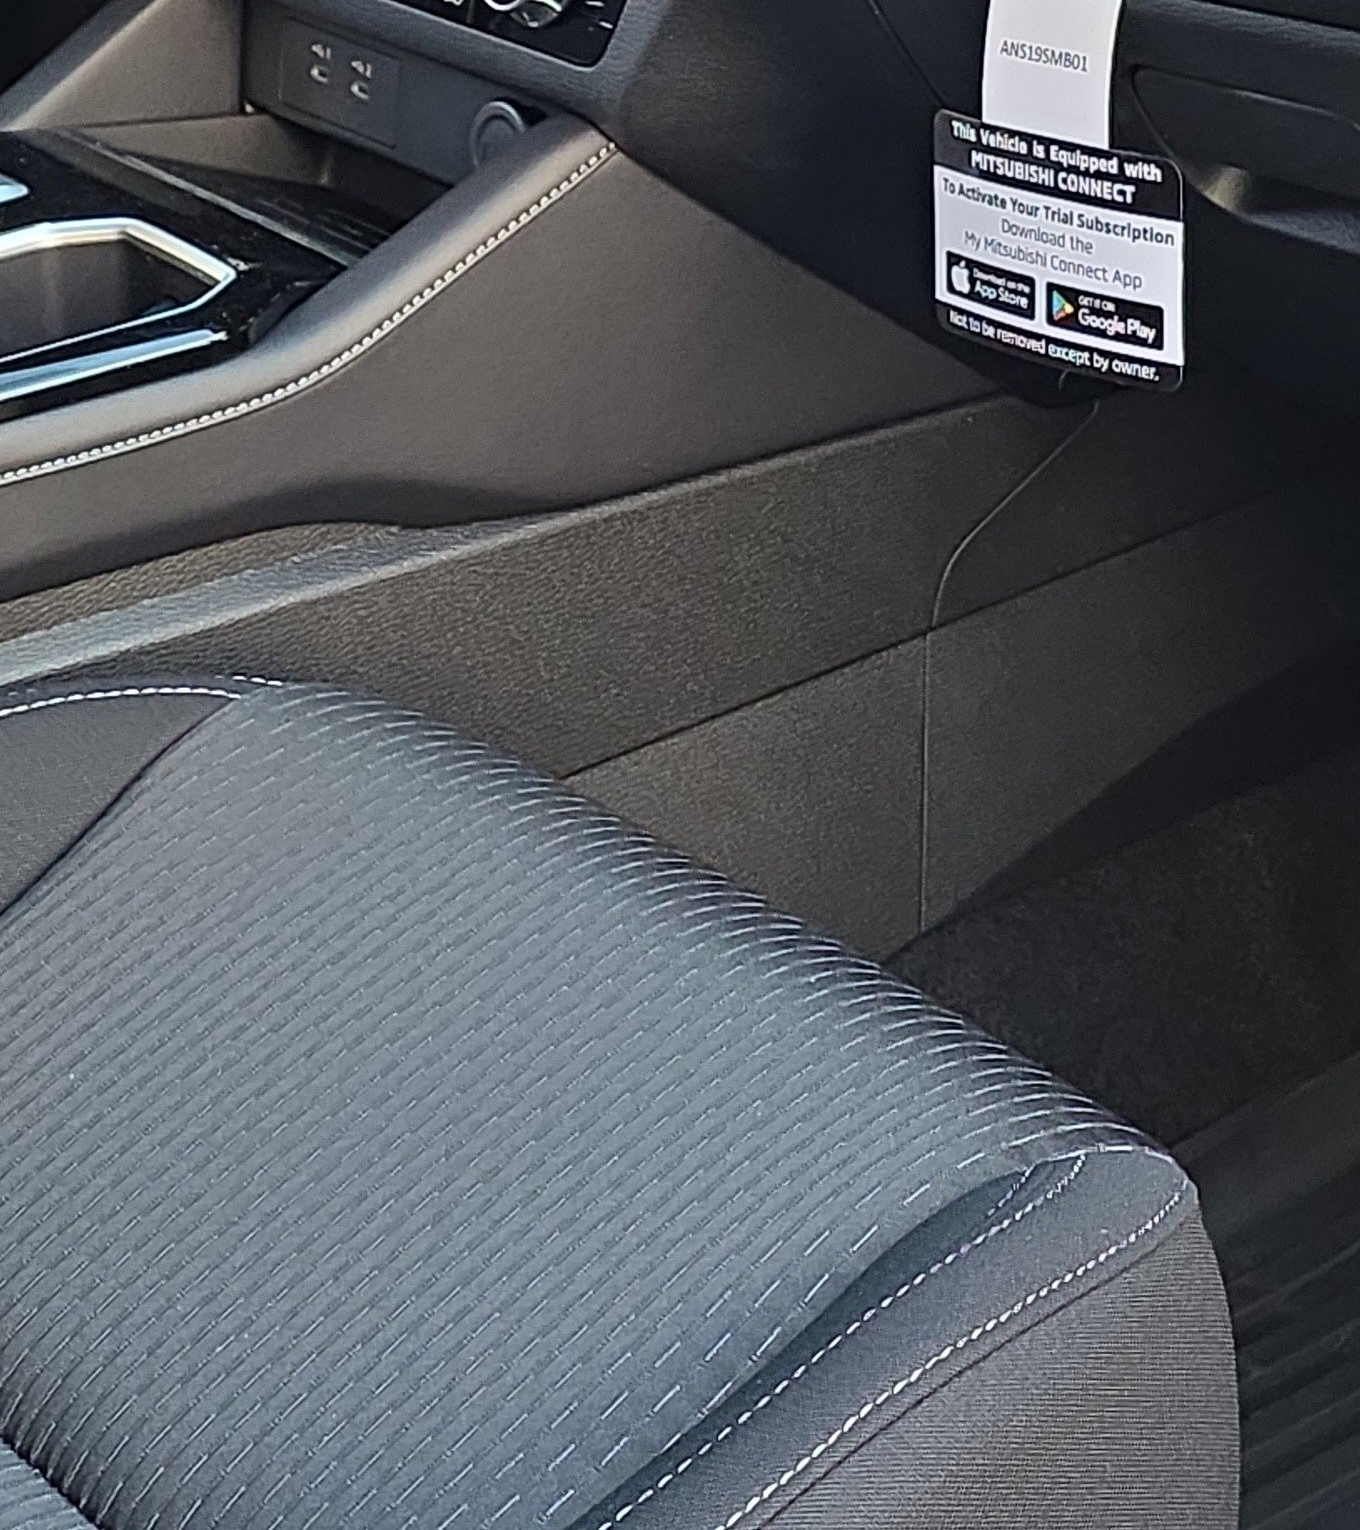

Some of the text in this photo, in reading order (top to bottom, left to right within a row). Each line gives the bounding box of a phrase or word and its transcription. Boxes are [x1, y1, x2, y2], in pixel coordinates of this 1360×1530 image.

[951, 119, 1163, 183] This Vehicle is Equipped with
[970, 149, 1136, 204] MITSUBISHI CONNECT
[943, 177, 1175, 247] To Activate Your Trial Subscription
[1001, 218, 1093, 255] Download the
[964, 230, 1142, 291] My Mitsubishi Connect App
[974, 280, 1029, 310] App Store
[949, 309, 969, 330] Not
[969, 317, 981, 333] to
[981, 320, 996, 339] be
[996, 328, 1046, 355] removed
[1048, 343, 1091, 367] except
[1092, 352, 1110, 373] by
[1077, 308, 1156, 345] Google Play
